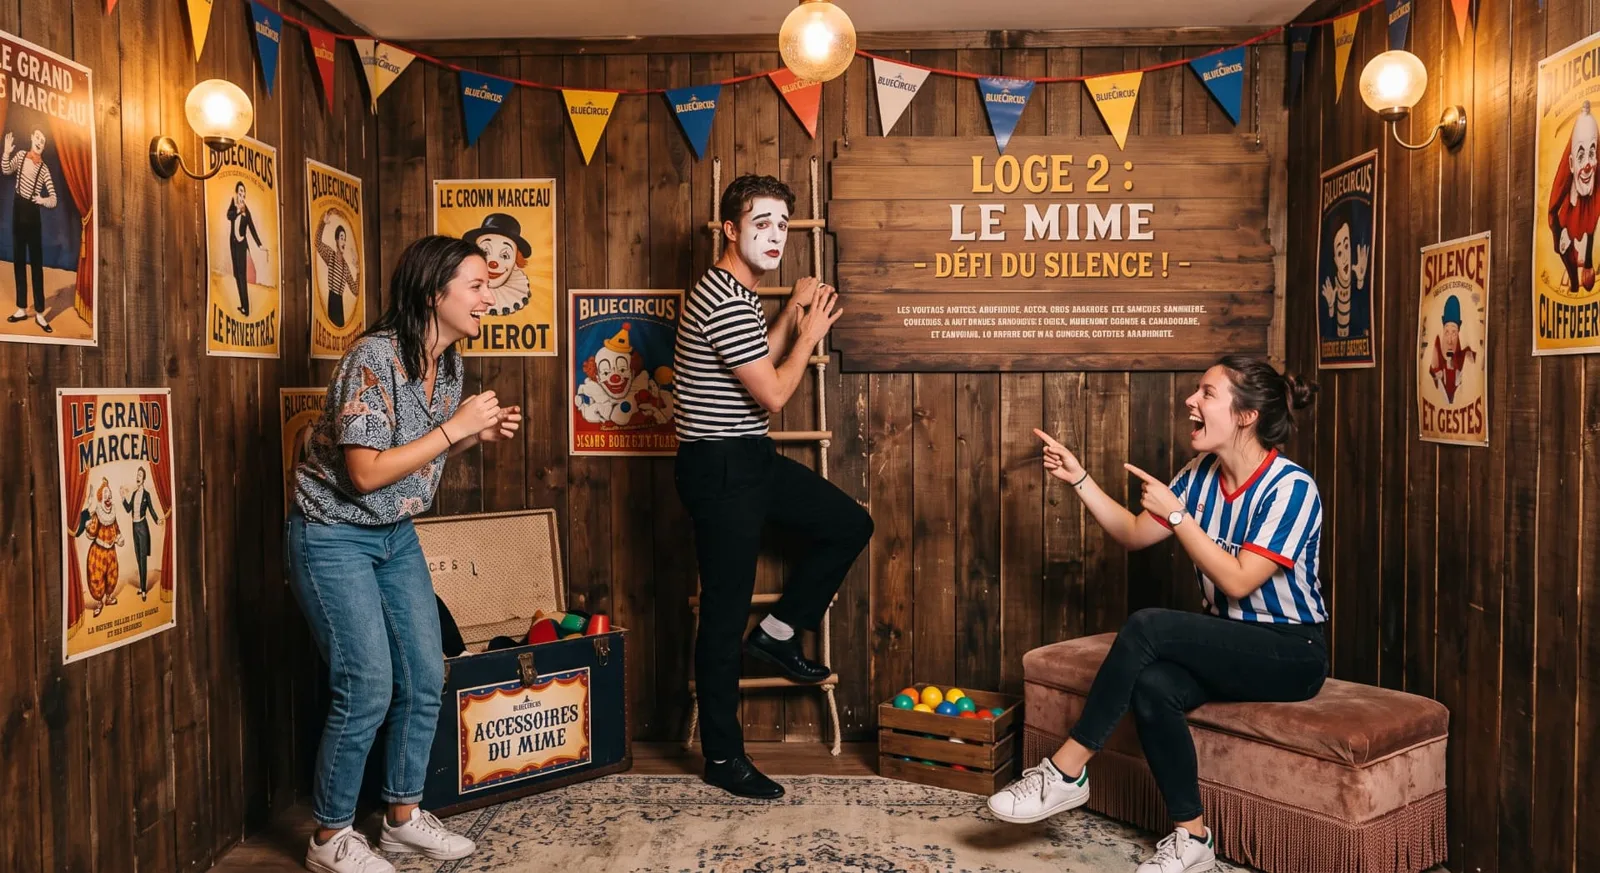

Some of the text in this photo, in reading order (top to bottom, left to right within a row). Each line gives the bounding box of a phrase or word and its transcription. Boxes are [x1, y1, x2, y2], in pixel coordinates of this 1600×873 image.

[0, 44, 73, 94] E GRAND
[877, 76, 917, 93] BLUECIRCUS
[1203, 63, 1243, 82] BLUECIRCUS
[11, 77, 88, 126] MARCEAU
[464, 87, 503, 103] BLUECIRCUS
[570, 106, 609, 116] BLUECIRCUS
[675, 100, 715, 113] BLUECIRCUS
[985, 92, 1026, 105] BLUECIRCUS
[1095, 89, 1136, 102] BLUECIRCUS
[971, 154, 1073, 194] LOGE
[1086, 154, 1110, 193] 2
[1324, 164, 1372, 210] BLUECIRCUS
[440, 188, 550, 208] LE CRONN MARCEAU
[949, 203, 1155, 241] LE MIME
[934, 246, 993, 278] DÉFI
[1001, 252, 1037, 278] DU
[1044, 252, 1154, 278] SILENCE
[1425, 244, 1485, 296] SILENCE
[213, 303, 224, 343] LE
[579, 298, 676, 321] BLUECIRCUS
[897, 306, 910, 314] LES
[467, 324, 550, 350] PIEROT
[71, 401, 162, 439] LE GRAND
[1422, 396, 1482, 434] ET GESTES
[78, 433, 161, 475] MARCEAU
[473, 704, 579, 742] ACCESSOIRES
[488, 728, 566, 761] DU MIME
